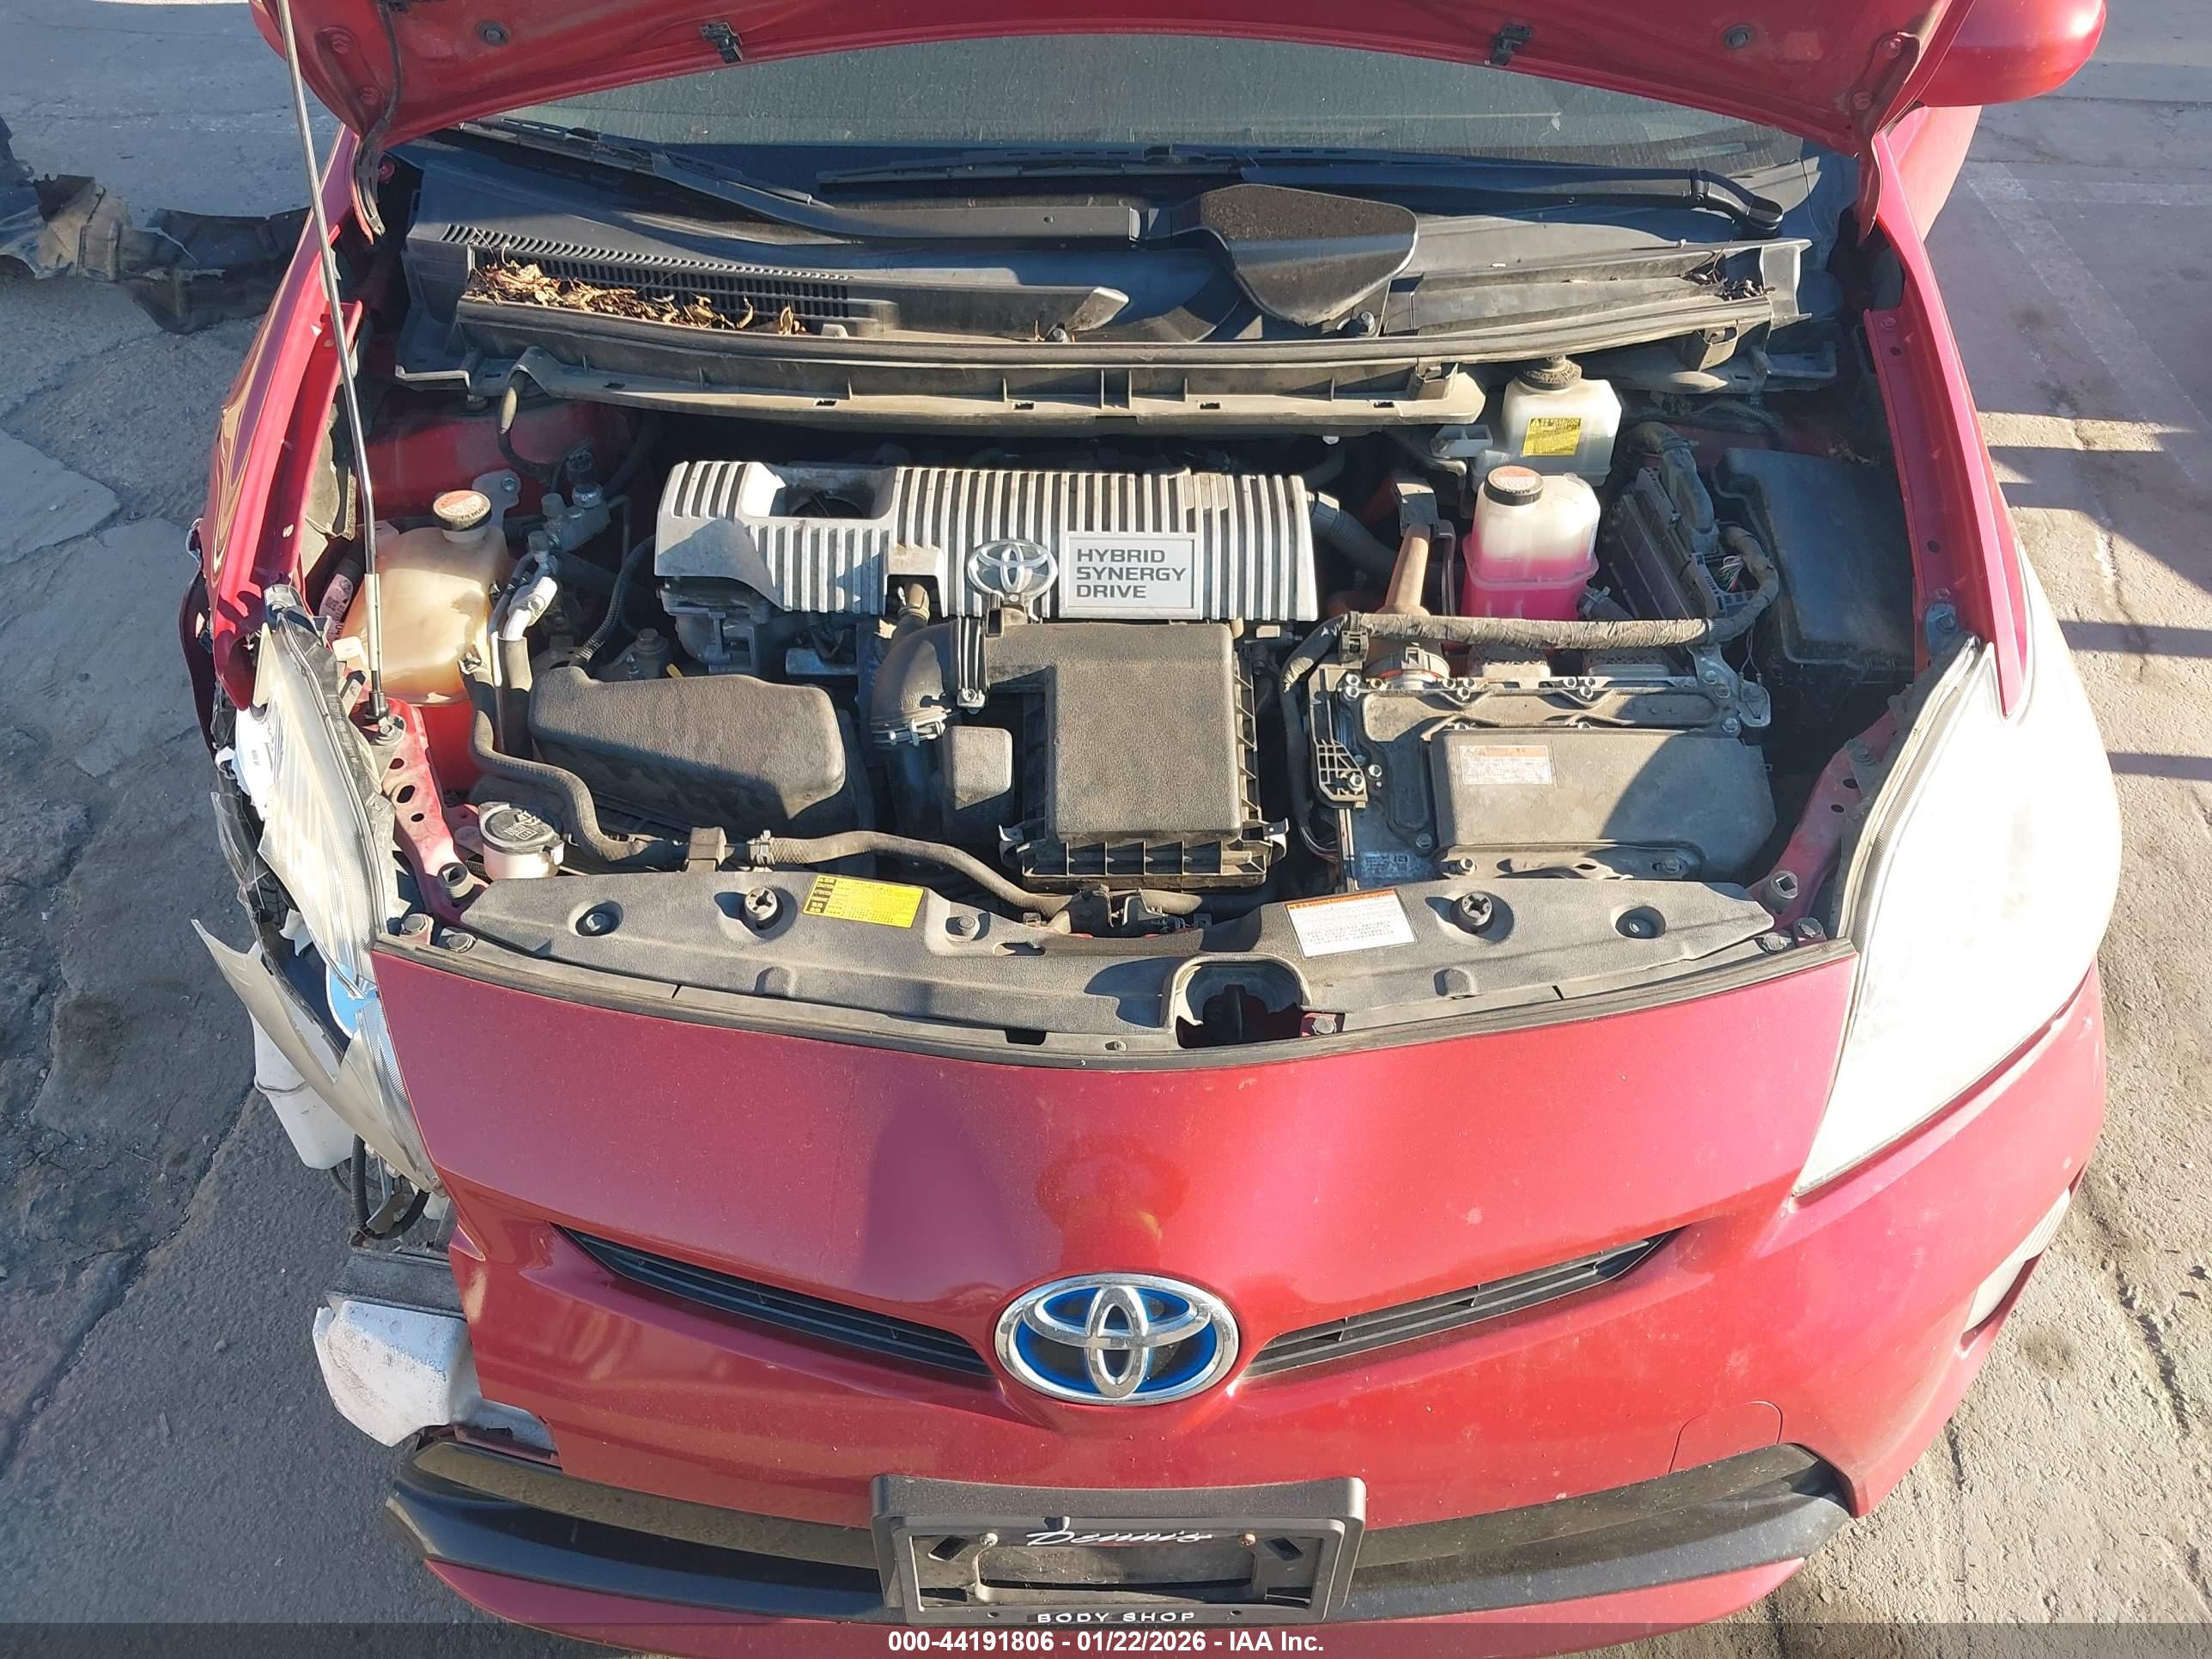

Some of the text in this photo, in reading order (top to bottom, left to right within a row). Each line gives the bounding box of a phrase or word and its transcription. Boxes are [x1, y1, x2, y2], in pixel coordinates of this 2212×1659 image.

[1076, 548, 1165, 563] HYBRID
[1076, 567, 1187, 580] SYNERGY
[1076, 584, 1147, 599] DRIVE
[1036, 1611, 1195, 1624] BODY SHOP
